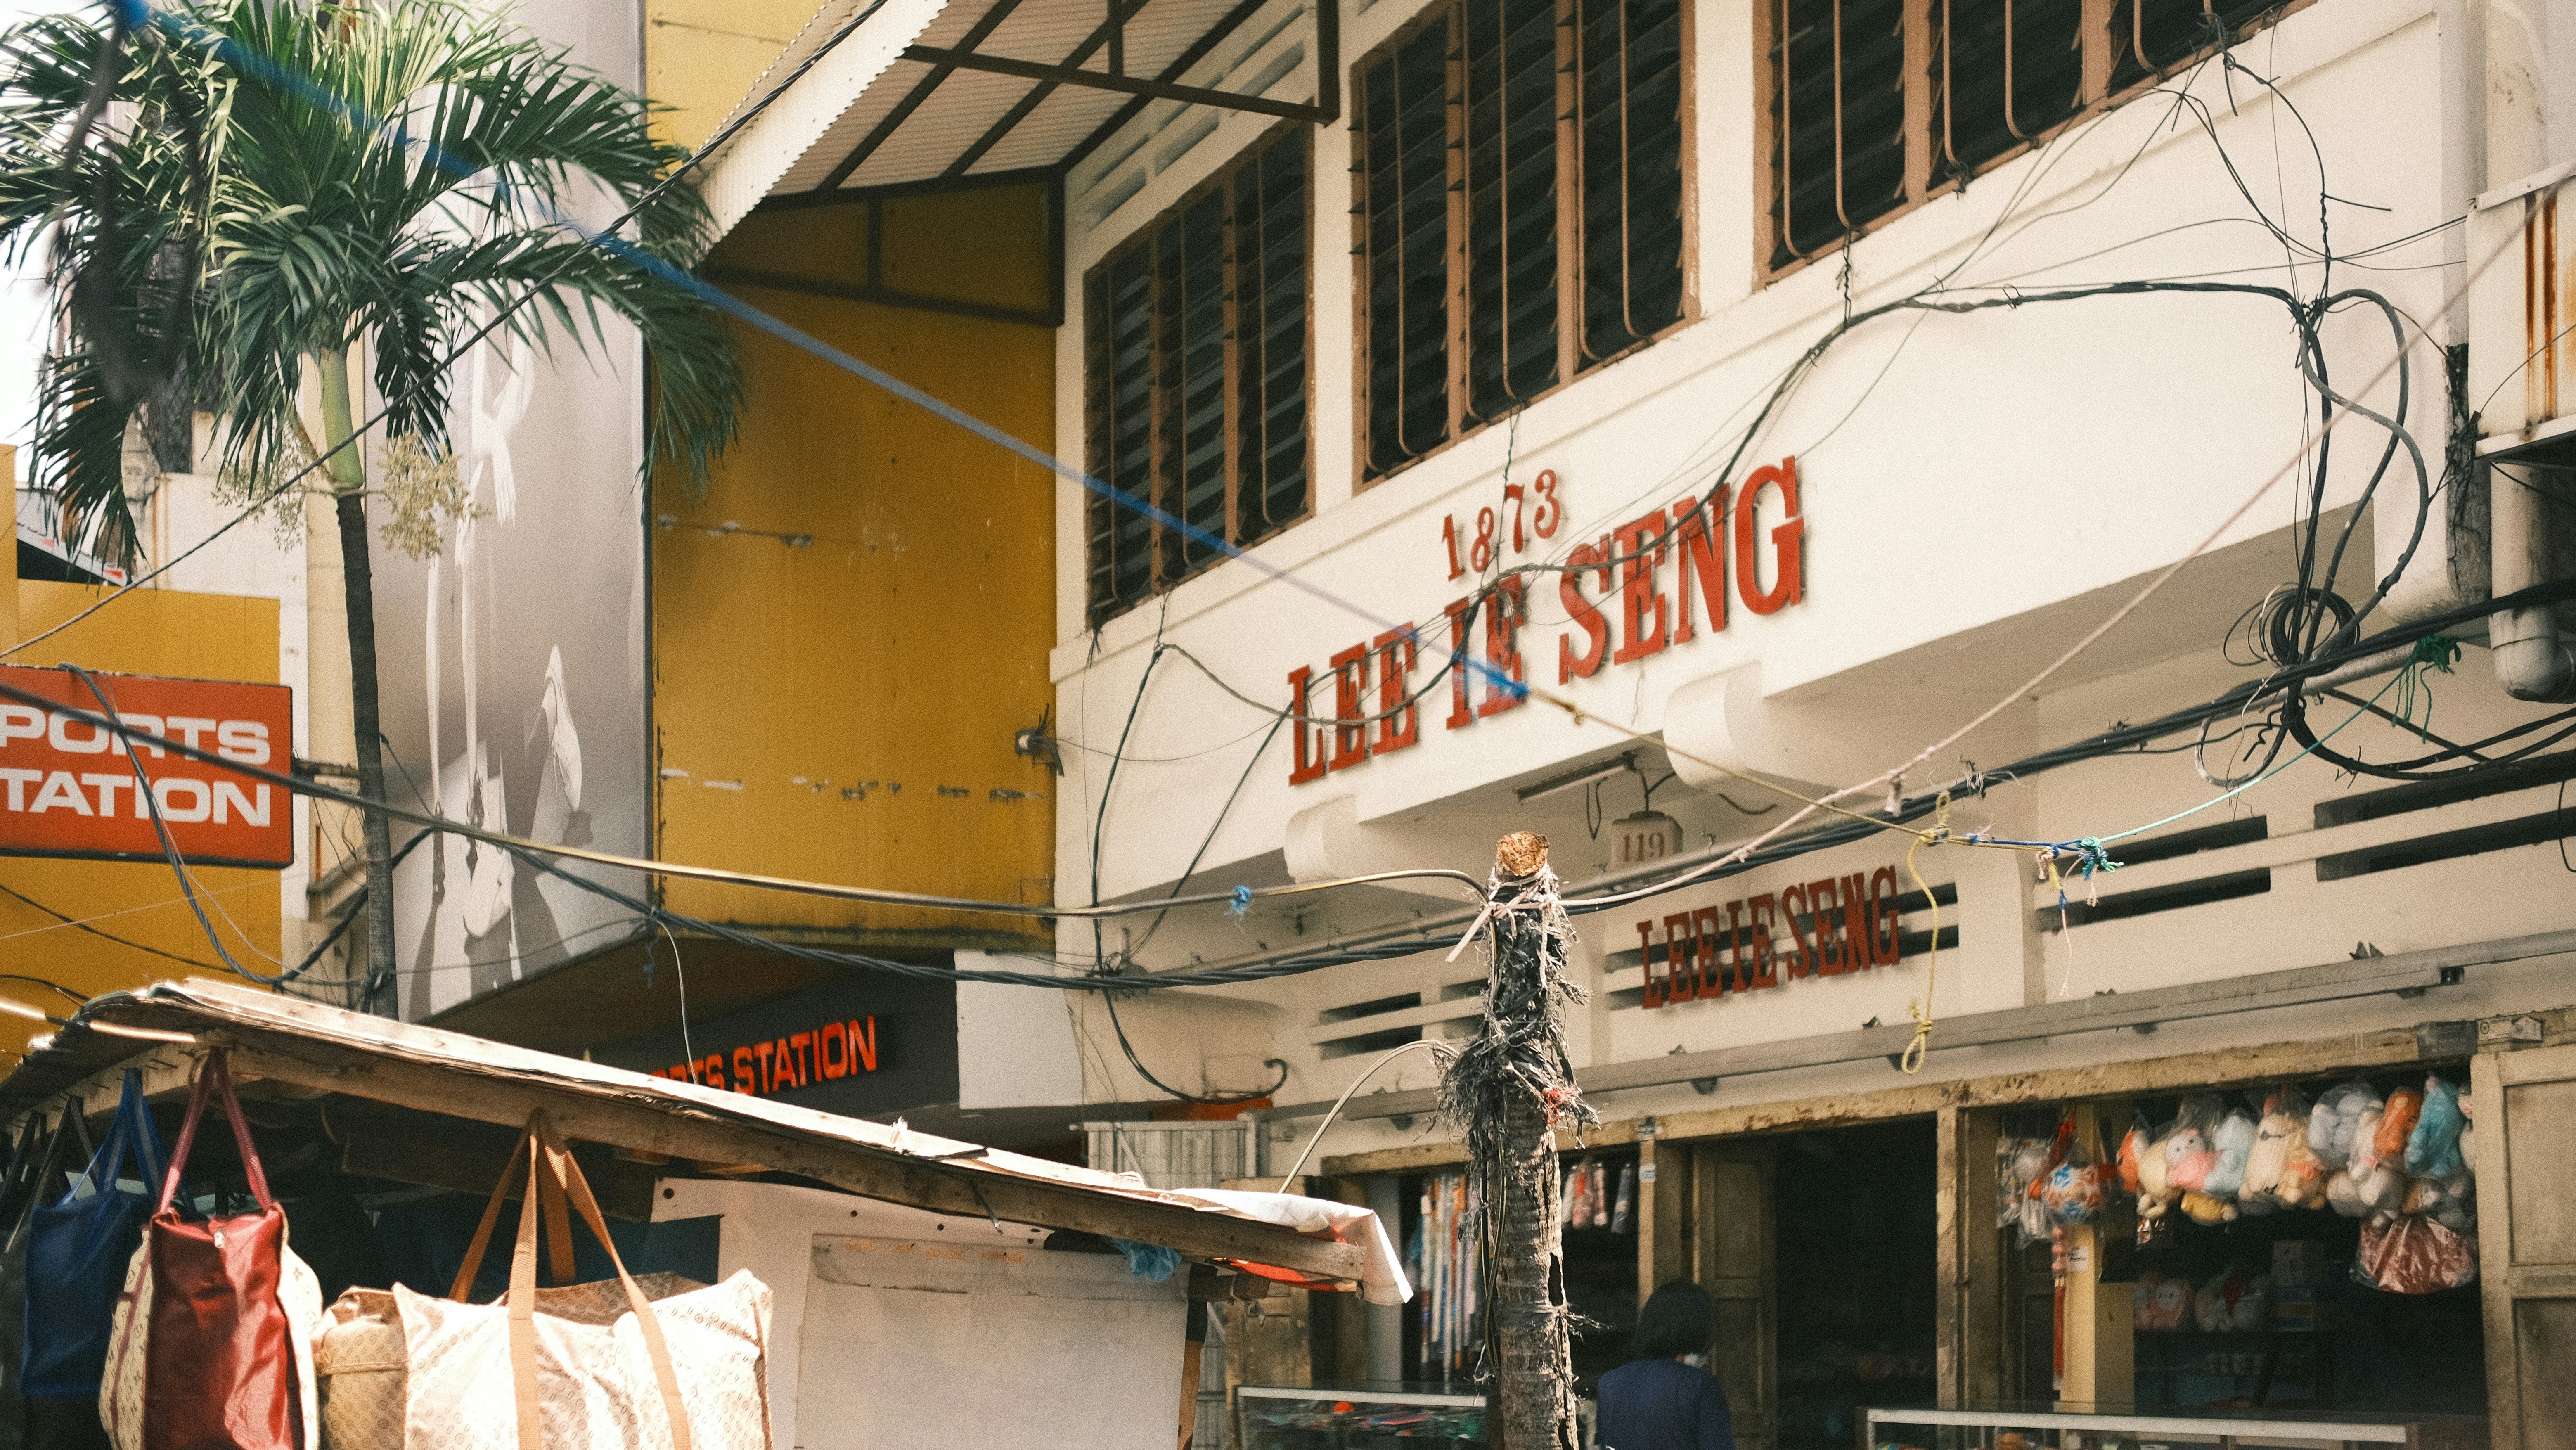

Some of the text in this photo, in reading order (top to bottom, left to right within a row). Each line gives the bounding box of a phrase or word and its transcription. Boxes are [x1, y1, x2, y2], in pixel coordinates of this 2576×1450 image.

[1441, 468, 1561, 581] 1873
[1288, 455, 1804, 786] LEE IE SENG
[1623, 832, 1665, 863] 119
[1636, 865, 1901, 1010] LEE IE SENG
[733, 1015, 877, 1097] STATION
